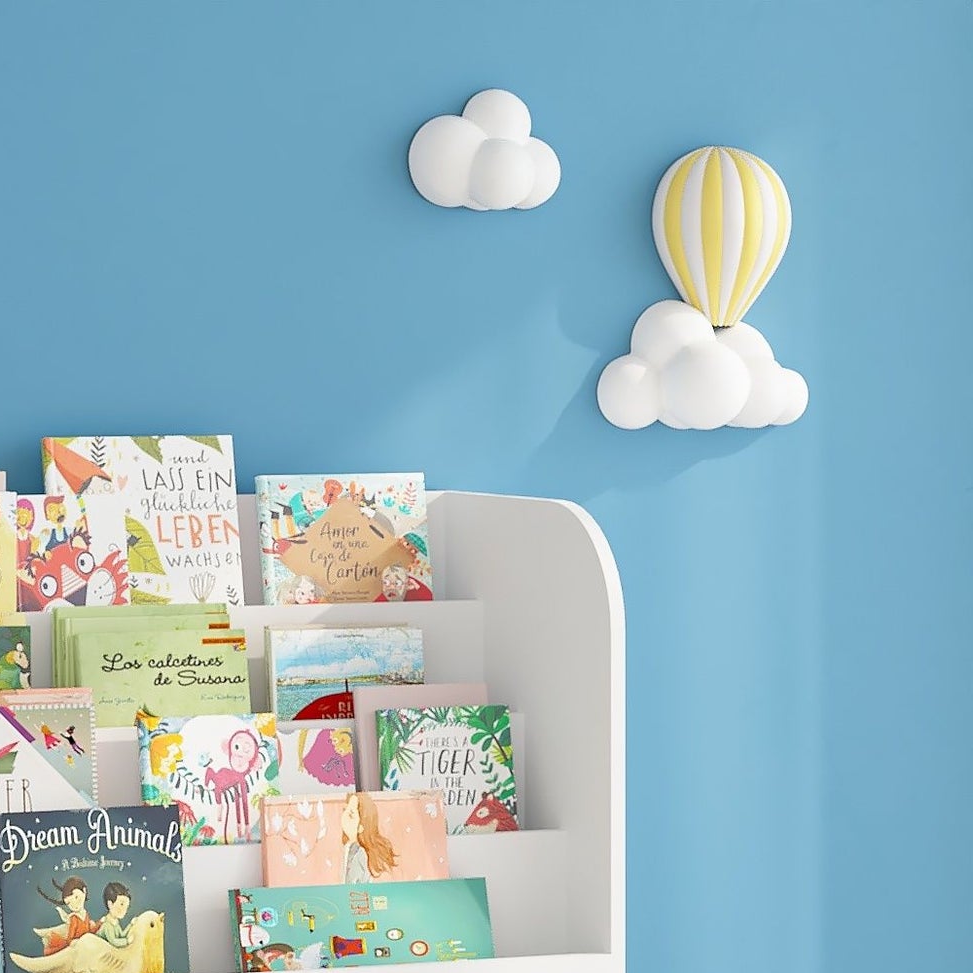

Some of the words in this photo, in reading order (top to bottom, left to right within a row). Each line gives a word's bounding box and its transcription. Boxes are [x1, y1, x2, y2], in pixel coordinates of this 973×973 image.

[171, 450, 209, 464] und
[142, 467, 185, 492] LASS
[320, 521, 360, 539] Amor
[327, 561, 379, 585] Cartón
[101, 653, 143, 672] Los
[148, 654, 224, 669] calcetines
[154, 672, 173, 686] de
[177, 670, 246, 687] Susana
[416, 748, 477, 776] TIGER
[430, 777, 440, 788] IS
[445, 777, 465, 789] THE
[0, 819, 83, 873] Dream
[87, 807, 183, 863] Animals
